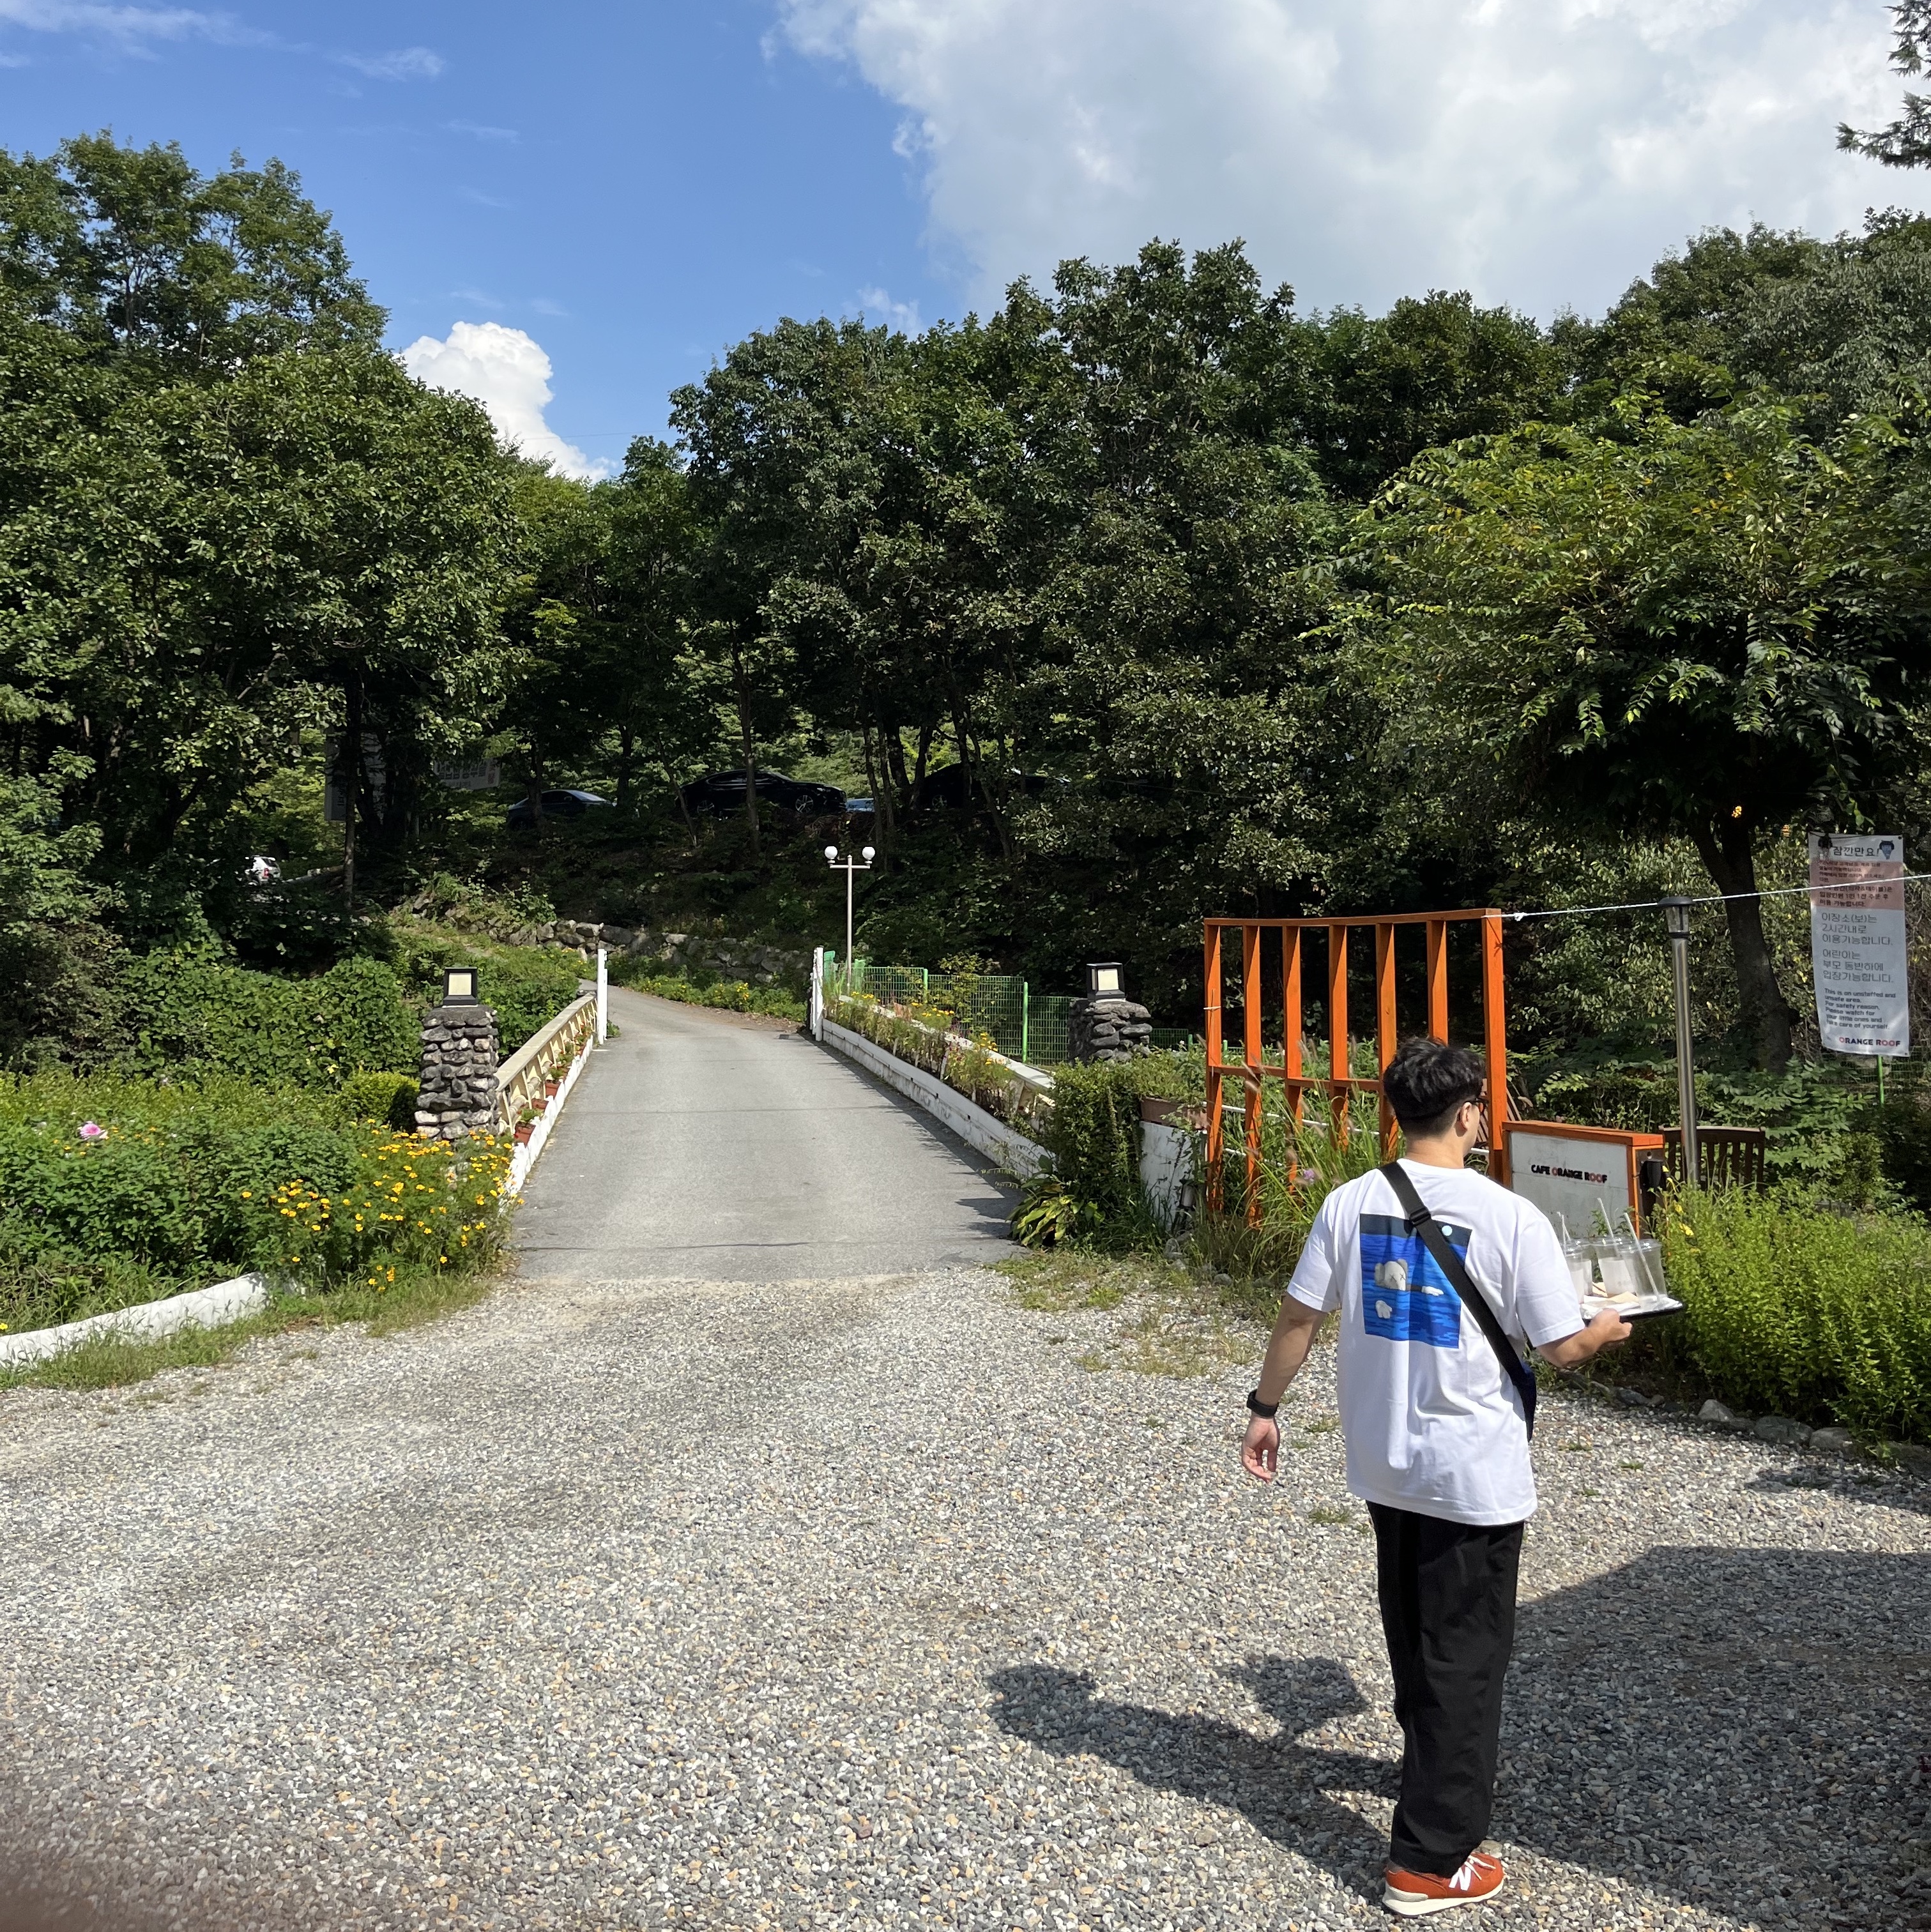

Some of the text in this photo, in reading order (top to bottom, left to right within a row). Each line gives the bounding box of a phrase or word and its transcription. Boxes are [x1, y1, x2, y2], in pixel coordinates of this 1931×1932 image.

[1822, 923, 1866, 934] 2시간내로
[1822, 948, 1860, 959] 어린이는
[1823, 959, 1884, 971] 부모 동반하에
[1839, 1037, 1874, 1046] ORANGE
[1531, 1164, 1608, 1183] CAFE ORANGE ROOF
[1449, 1866, 1472, 1891] N
